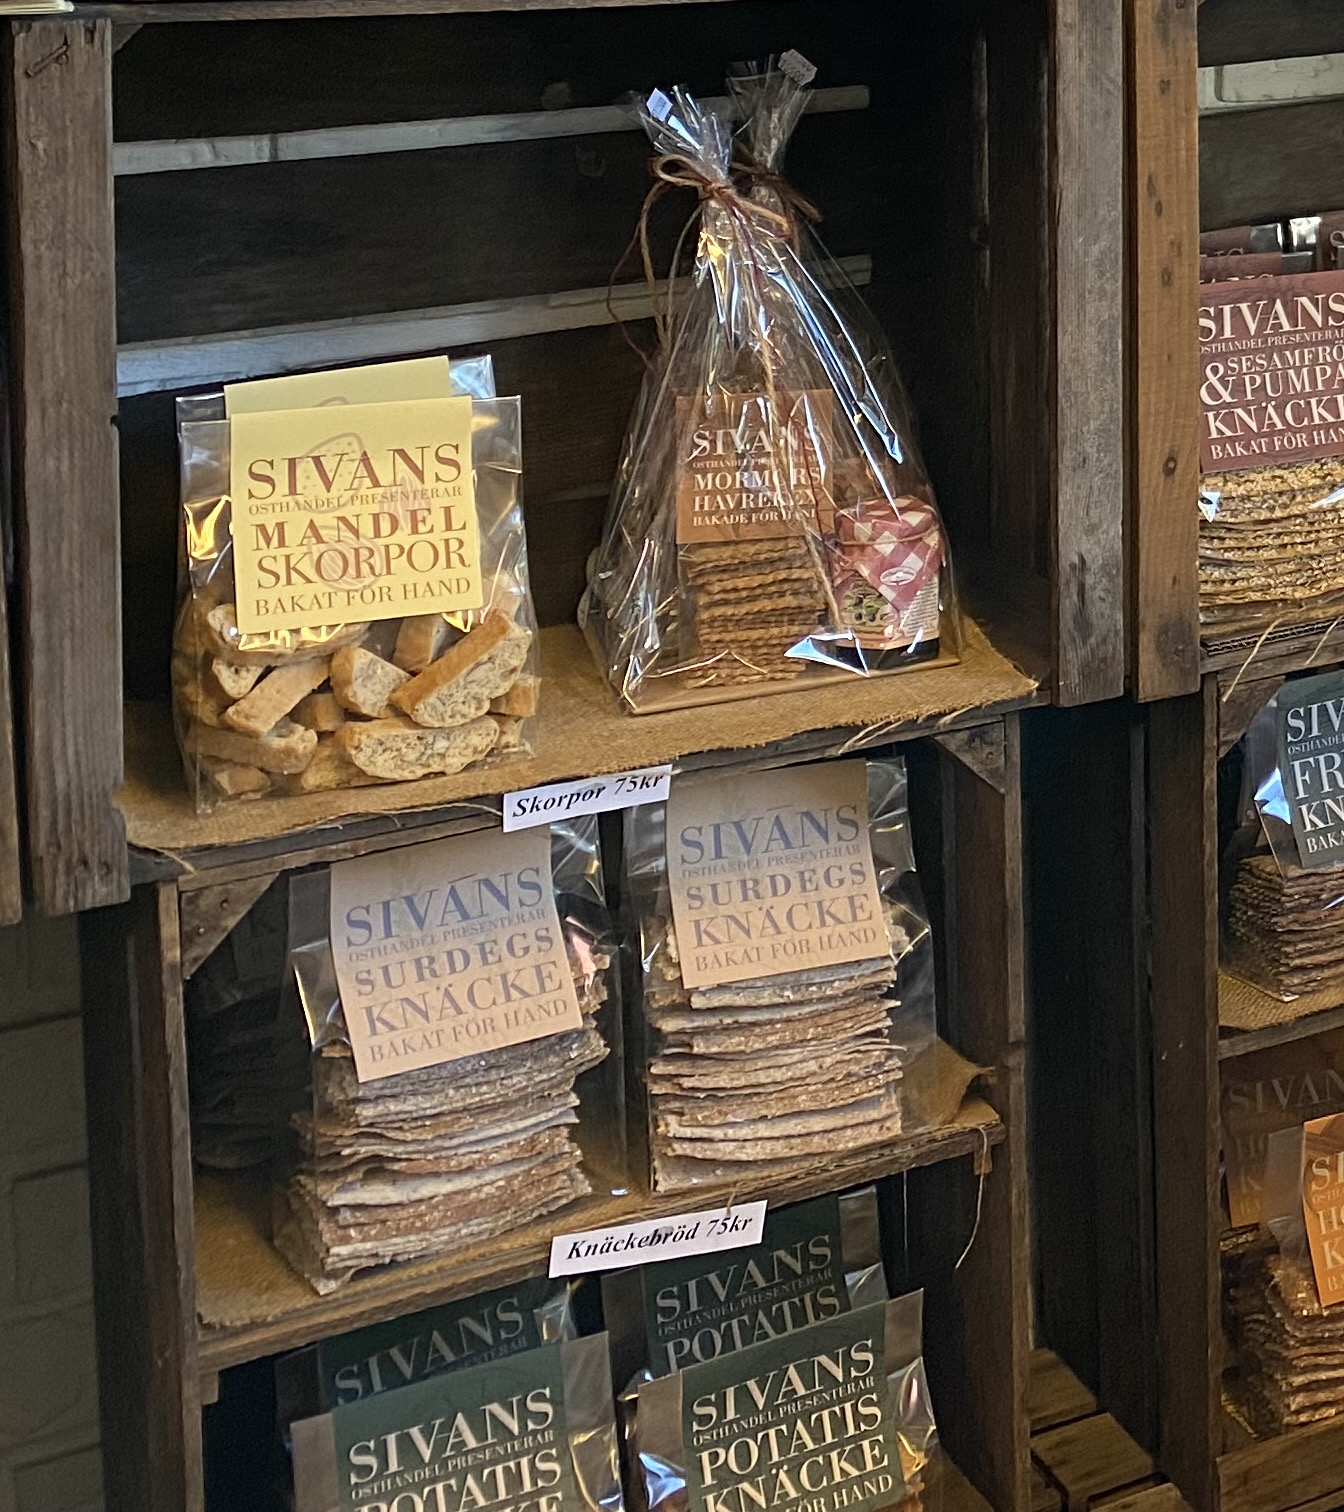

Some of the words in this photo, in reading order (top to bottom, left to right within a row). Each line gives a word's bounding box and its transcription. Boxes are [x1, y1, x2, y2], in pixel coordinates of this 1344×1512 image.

[1200, 362, 1237, 406] &
[247, 443, 462, 501] SIVANS
[1211, 439, 1270, 460] BAKAT
[1274, 432, 1309, 452] FÖR
[350, 486, 462, 507] PRESENTERAR
[252, 505, 467, 552] MANDEL
[257, 536, 471, 590] SKORPOR
[254, 591, 338, 617] BAKAT
[346, 584, 393, 606] FÖR
[402, 577, 471, 601] HAND
[512, 787, 606, 818] Skorpor
[614, 773, 664, 795] 75kr
[679, 804, 860, 865] SIVANS
[767, 843, 861, 867] PRESENTERAR
[345, 866, 544, 948] SIVANS
[686, 861, 867, 911] SURDEGS
[443, 908, 547, 942] PRESENTERAR
[688, 892, 874, 949] KNÄCKE
[355, 926, 554, 998] SURDEGS
[694, 946, 765, 973] BAKAT
[770, 938, 812, 959] FÖR
[818, 926, 878, 952] HAND
[360, 959, 564, 1036] KNÄCKE
[368, 1028, 447, 1063] BAKAT
[452, 1012, 497, 1044] FÖR
[504, 996, 568, 1029] HAND
[566, 1222, 700, 1261] Knäckebröd
[706, 1215, 753, 1236] 75kr
[656, 1235, 832, 1325] SIVANS
[335, 1297, 523, 1406] SIVANS
[666, 1285, 840, 1374] POTATIS
[692, 1339, 874, 1433] SIVANS
[779, 1376, 875, 1418] PRESENTERAR
[349, 1386, 554, 1485] SIVANS
[447, 1429, 554, 1471] PRESENTERAR
[697, 1393, 882, 1488] POTATIS
[701, 1435, 889, 1512] KNÄCKE
[833, 1474, 893, 1511] HAND
